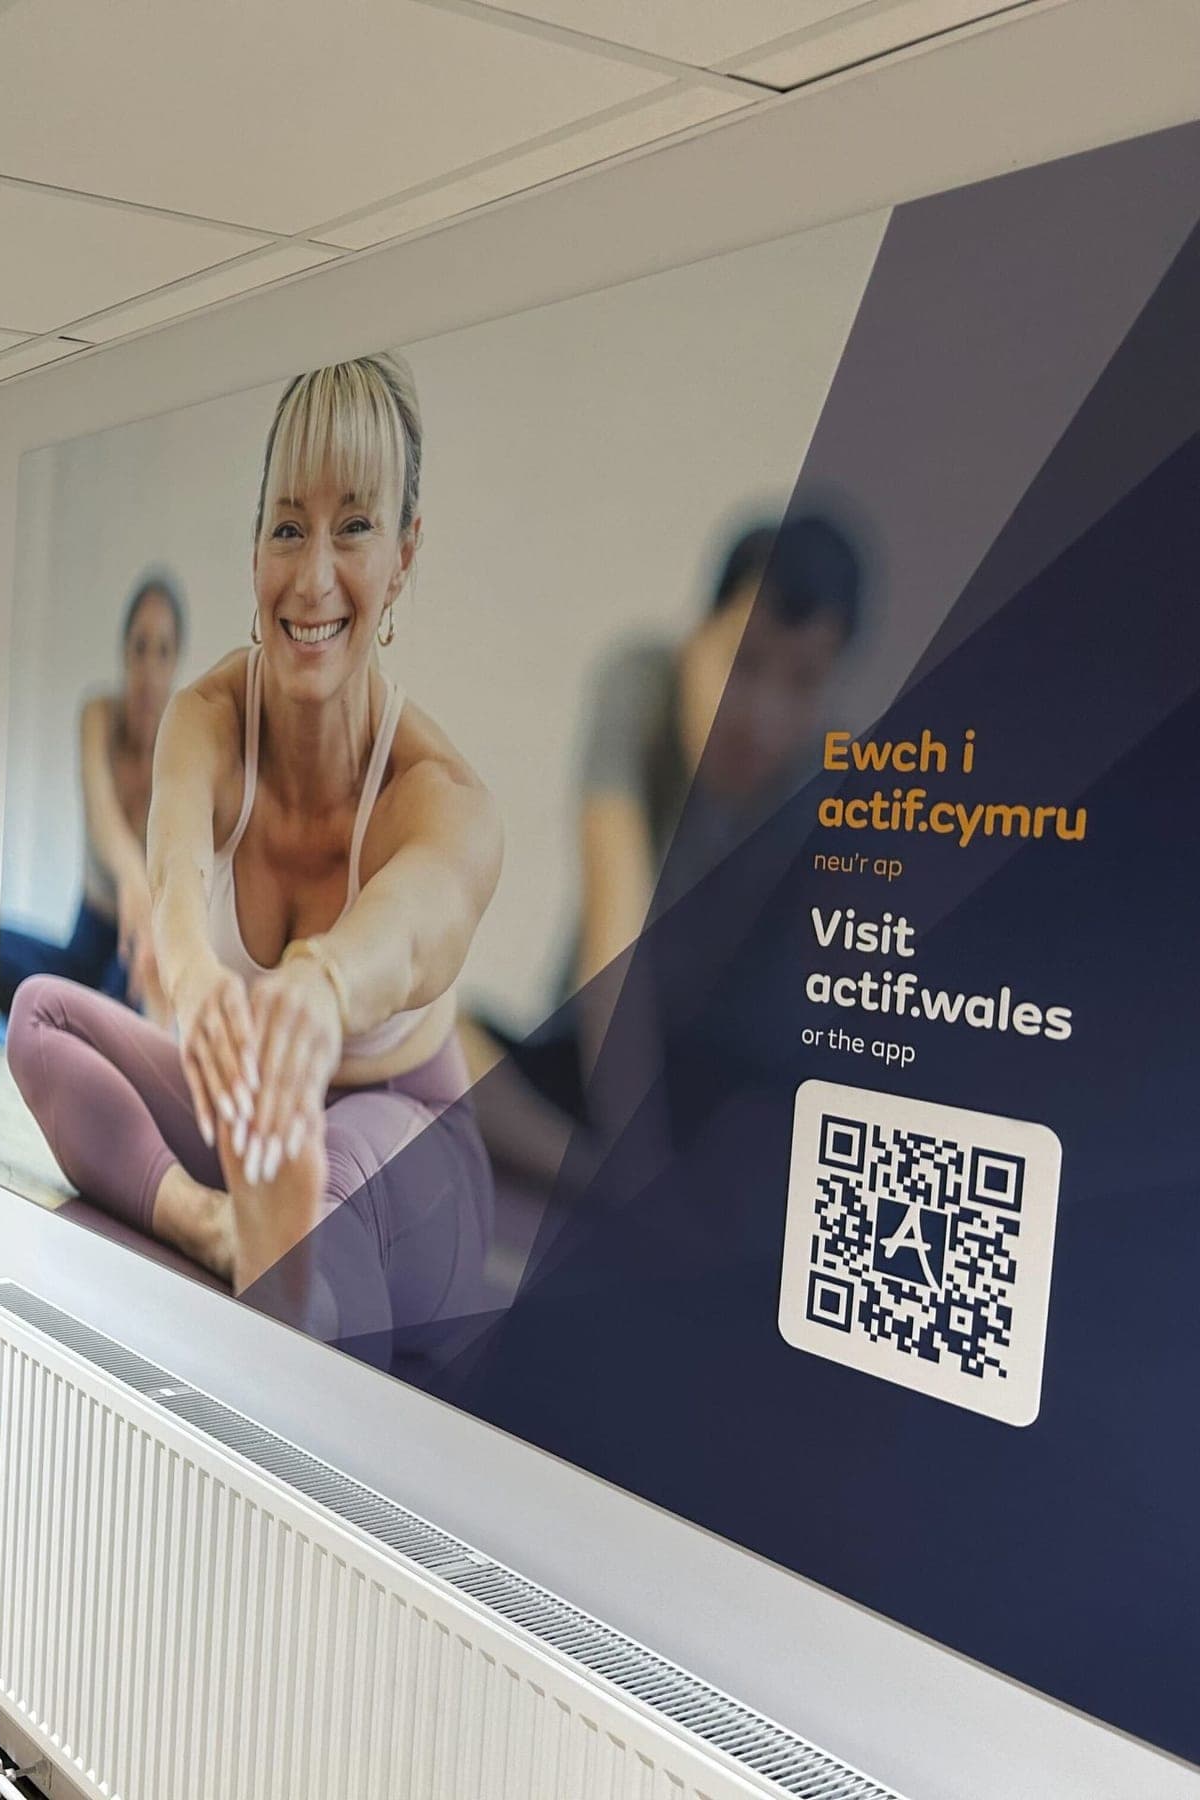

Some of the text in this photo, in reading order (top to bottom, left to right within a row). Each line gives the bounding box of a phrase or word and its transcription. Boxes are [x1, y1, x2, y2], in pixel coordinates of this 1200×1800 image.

[822, 728, 976, 774] Ewch i
[817, 787, 1088, 849] actif.cymru
[813, 852, 904, 883] neu'r ap
[810, 906, 916, 958] Visit
[805, 969, 1073, 1041] actif.wales
[801, 1027, 916, 1069] or the app
